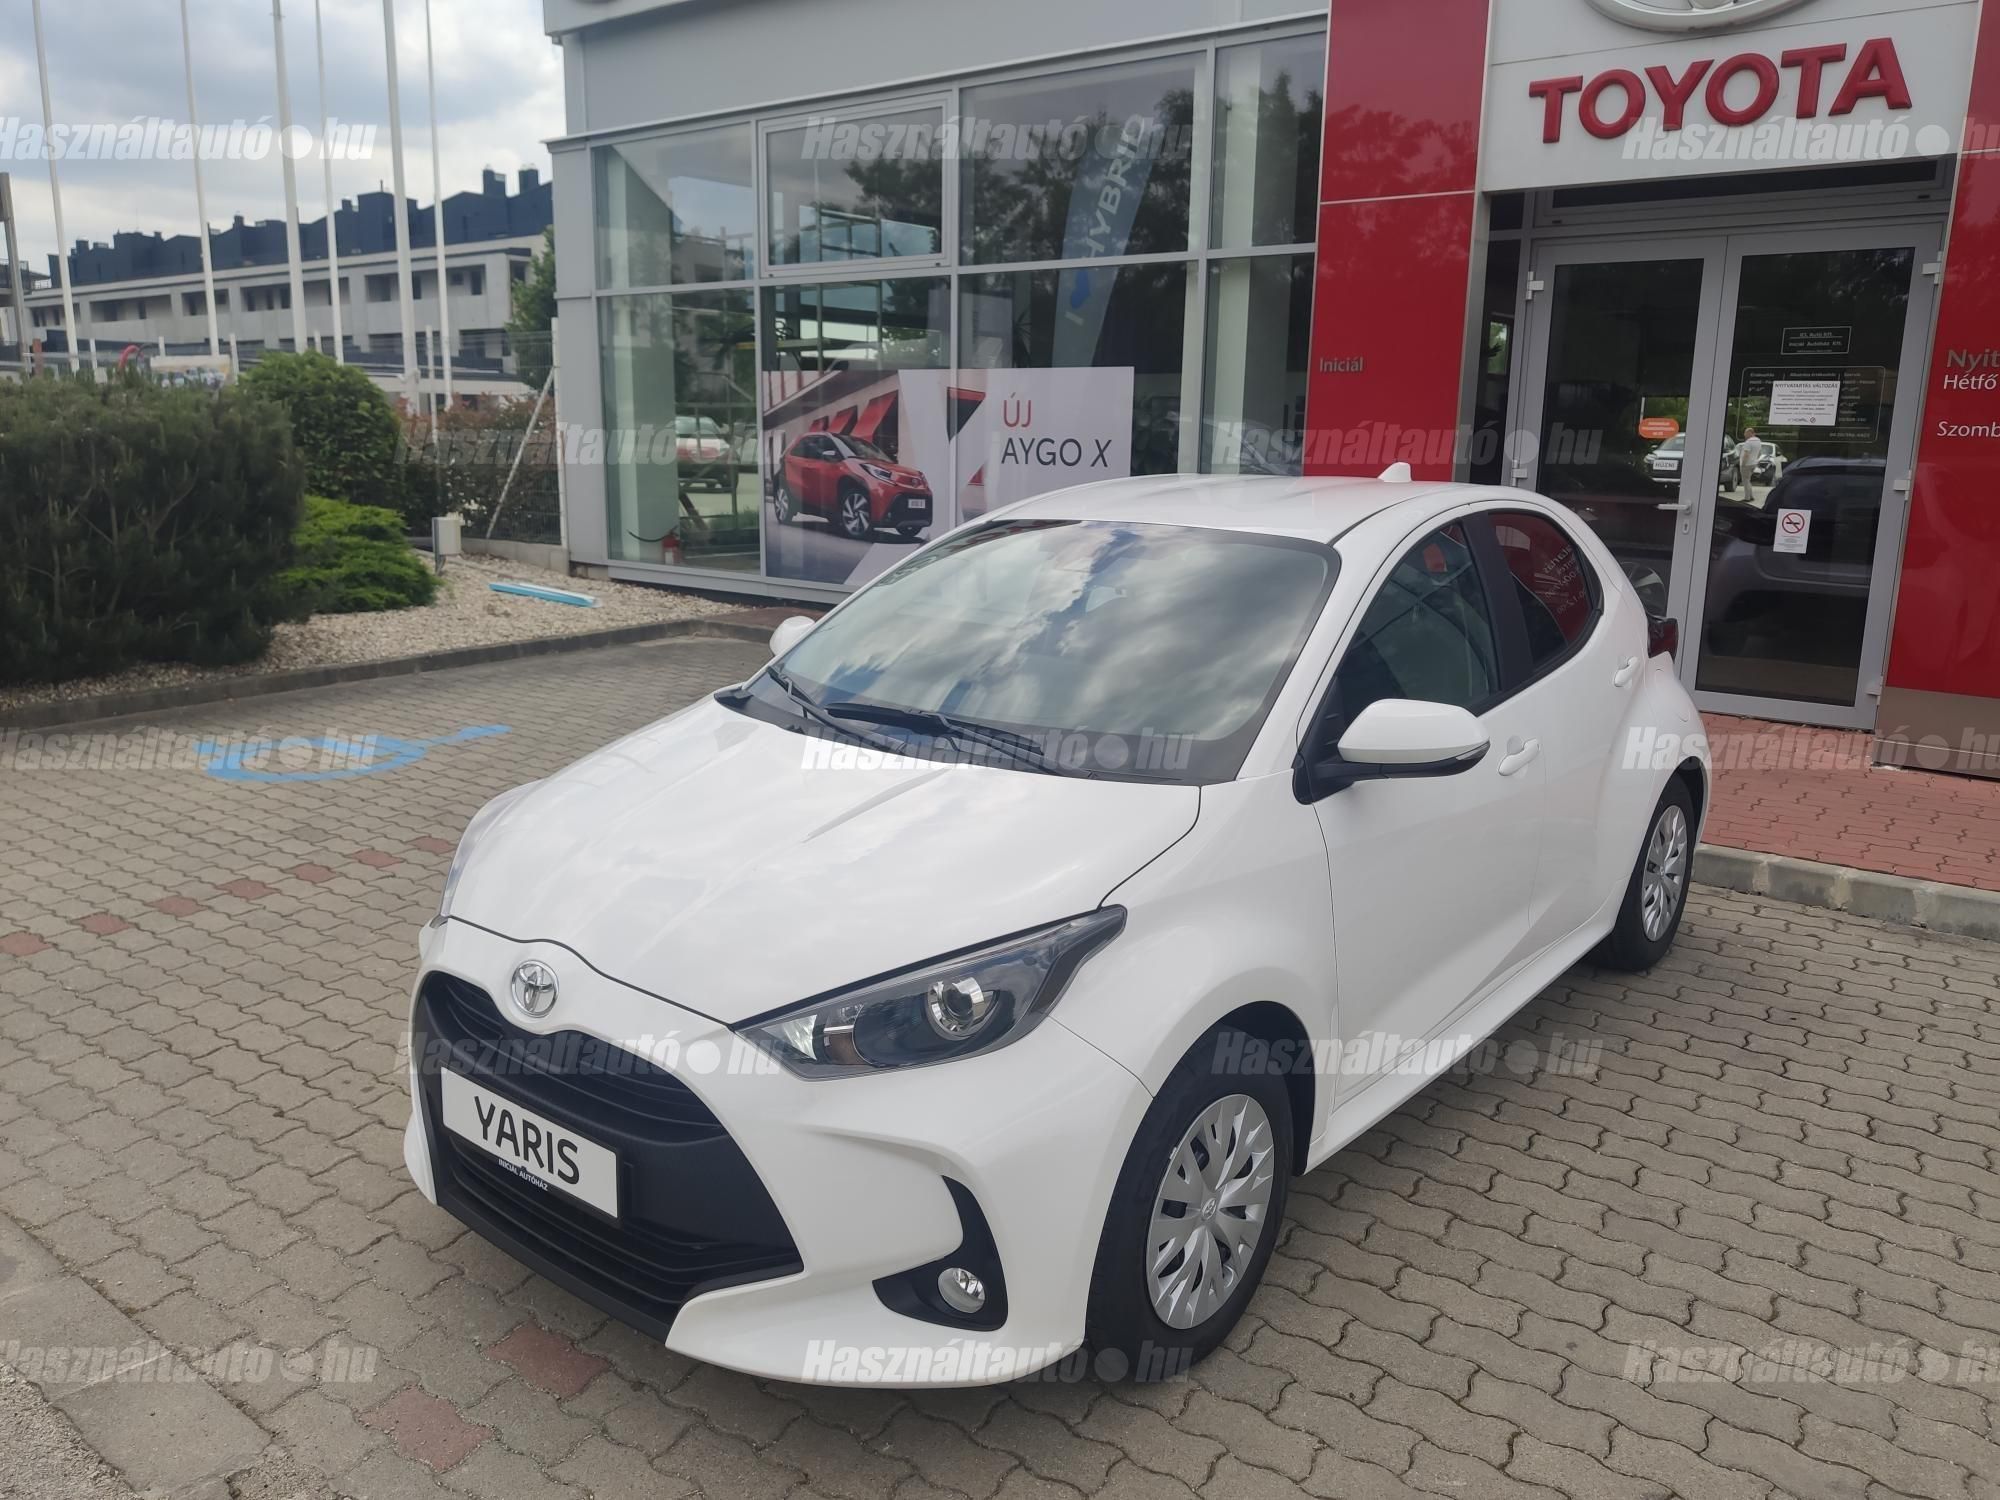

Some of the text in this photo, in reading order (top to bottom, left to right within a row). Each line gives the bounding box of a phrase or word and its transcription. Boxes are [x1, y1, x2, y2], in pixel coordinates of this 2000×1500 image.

[1529, 37, 1912, 143] TOYOTA
[1320, 356, 1364, 372] Iniciál
[1946, 349, 2000, 373] Nyit
[1943, 373, 1999, 390] Hétfő
[1003, 392, 1032, 428] ÚJ
[1937, 421, 2000, 437] Szomb
[1001, 437, 1113, 467] AYGO X
[474, 1095, 580, 1185] YARIS
[498, 1158, 548, 1191] INICIÁL AUTÓHÁZ
